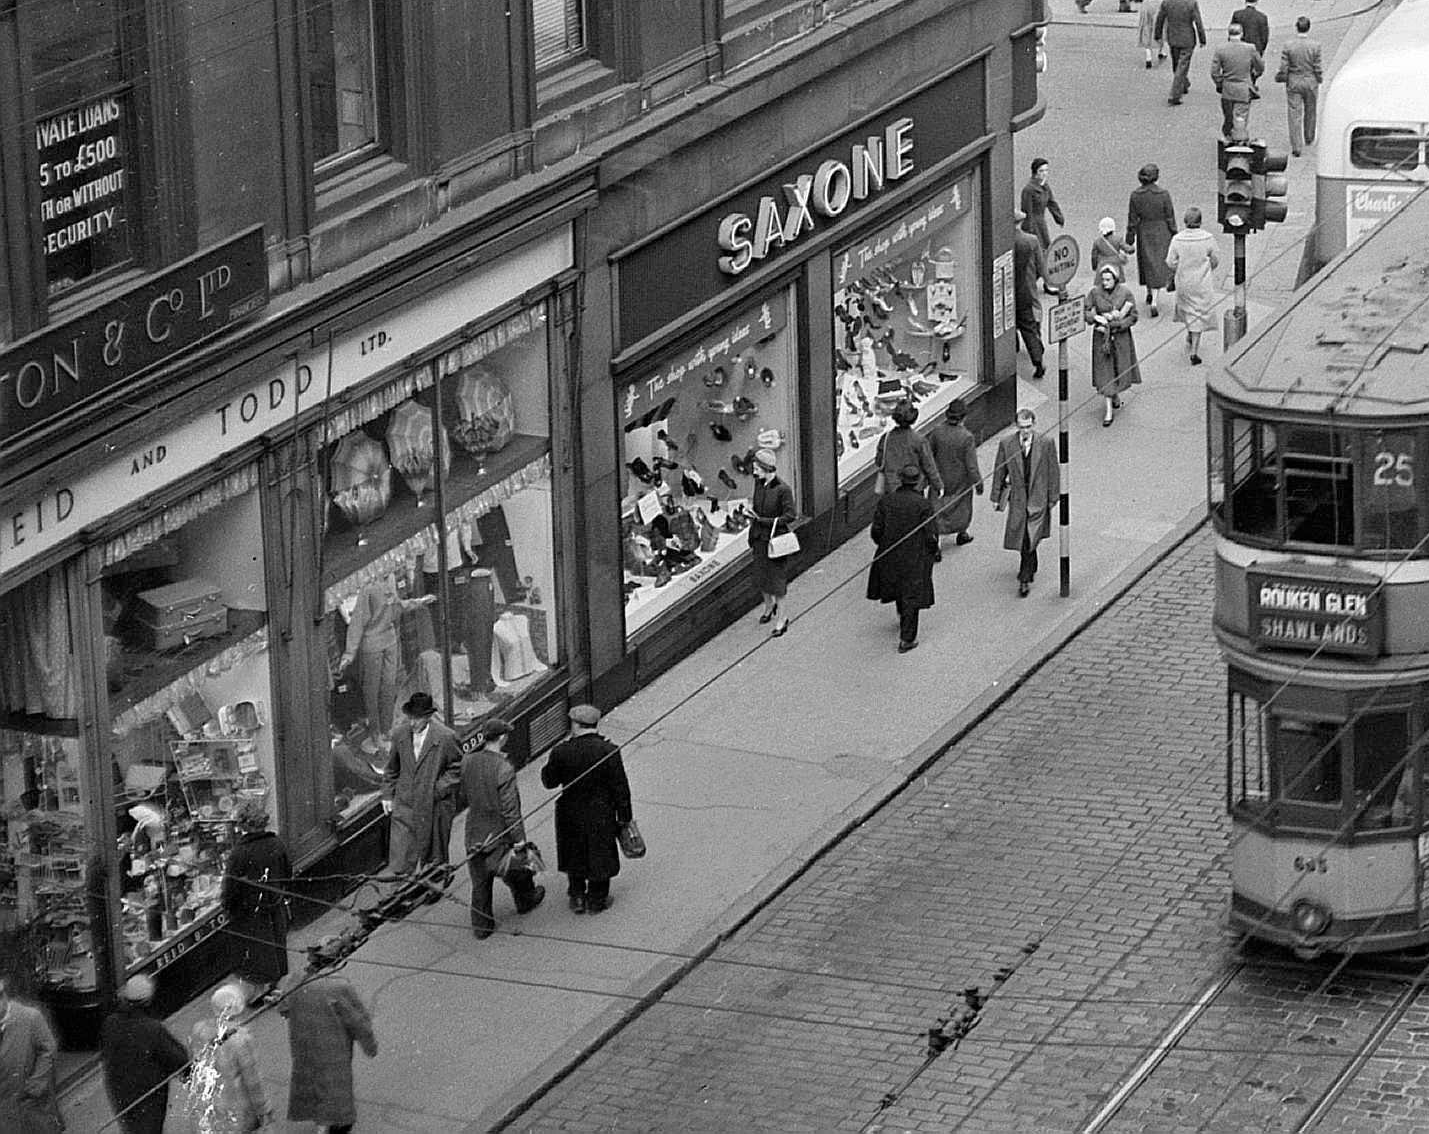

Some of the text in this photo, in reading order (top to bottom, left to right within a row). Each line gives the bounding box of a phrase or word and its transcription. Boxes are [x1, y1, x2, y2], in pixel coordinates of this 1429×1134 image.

[53, 160, 71, 181] TO
[73, 135, 116, 172] £500
[72, 168, 125, 208] WITHOUT
[717, 117, 915, 275] SAXONE
[1054, 246, 1069, 262] NO
[103, 320, 124, 366] &
[646, 375, 665, 401] The
[131, 444, 167, 476] AND
[216, 364, 312, 437] TODD
[1373, 452, 1414, 486] 25
[1259, 587, 1368, 617] ROUKEN GLEN
[1263, 617, 1369, 644] SHAWLANDS
